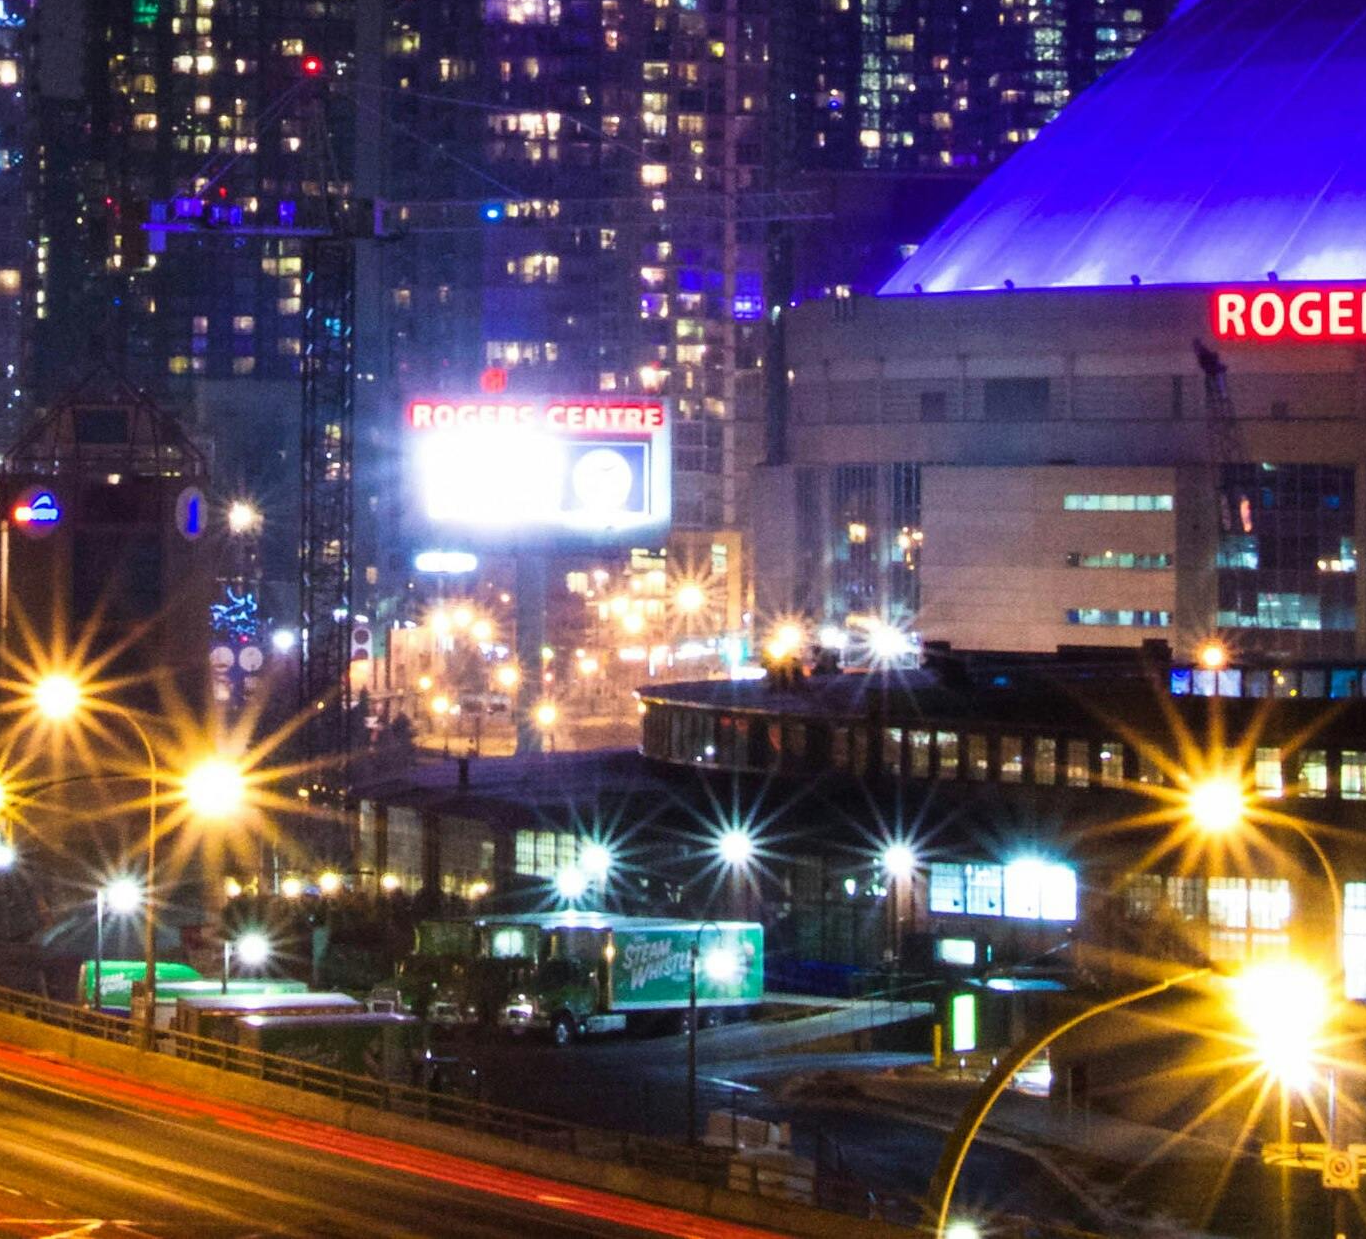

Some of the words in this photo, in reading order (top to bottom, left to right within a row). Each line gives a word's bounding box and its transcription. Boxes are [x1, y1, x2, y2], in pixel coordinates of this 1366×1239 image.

[412, 403, 535, 427] ROGERS
[545, 405, 663, 429] CENTRE
[622, 938, 672, 969] STEAM
